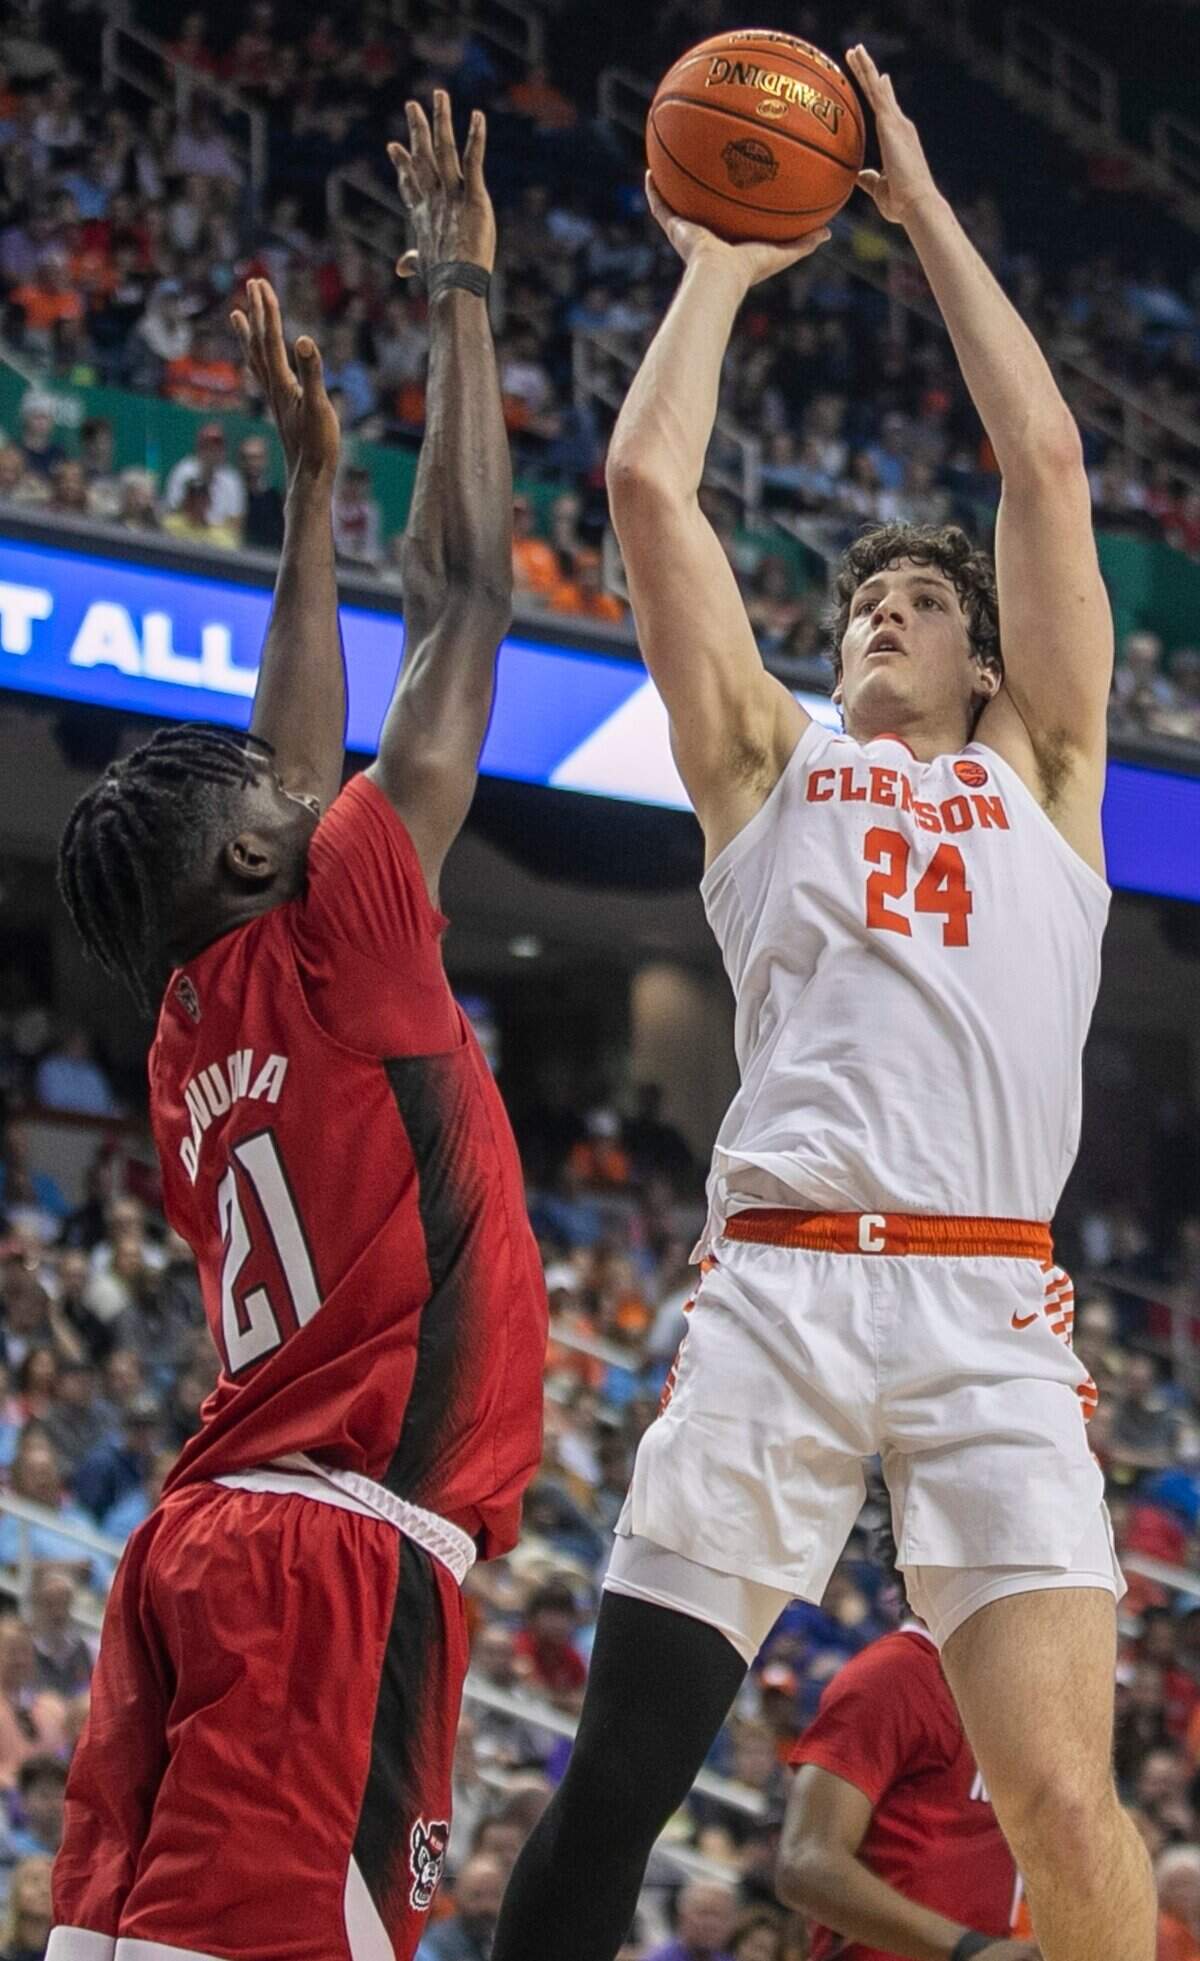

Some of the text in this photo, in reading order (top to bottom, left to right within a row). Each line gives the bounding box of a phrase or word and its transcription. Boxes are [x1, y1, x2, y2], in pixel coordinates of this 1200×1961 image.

[705, 57, 845, 134] SPALDING
[69, 601, 259, 698] ALL
[864, 827, 973, 947] 24
[217, 1131, 322, 1375] 21
[859, 1214, 886, 1252] C
